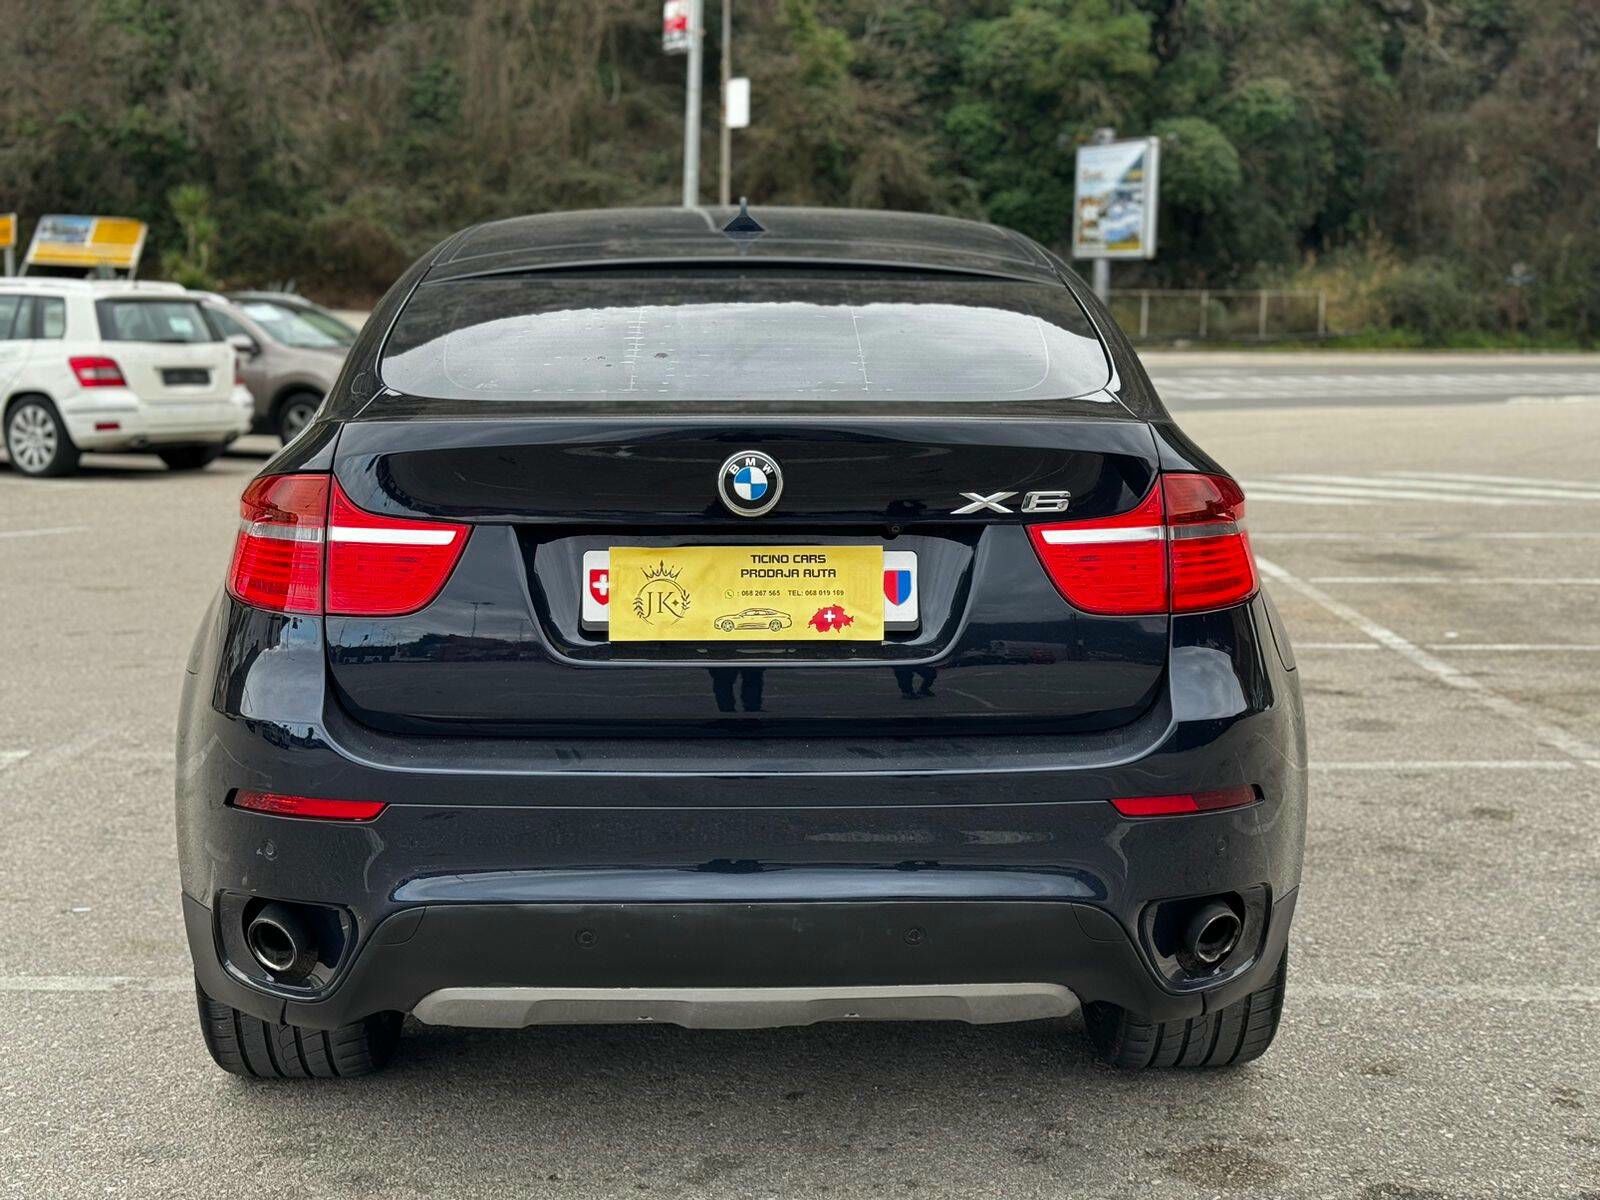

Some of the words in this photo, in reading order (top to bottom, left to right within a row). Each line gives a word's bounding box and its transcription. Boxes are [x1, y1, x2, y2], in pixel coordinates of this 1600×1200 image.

[730, 458, 777, 477] BMW
[950, 490, 1071, 514] X6
[750, 554, 789, 564] TICINO
[793, 554, 827, 564] CARS
[740, 568, 800, 578] PRODAJA
[803, 568, 837, 578] AUTA
[741, 589, 753, 597] 068
[788, 589, 803, 597] TEL:
[642, 591, 684, 619] JK
